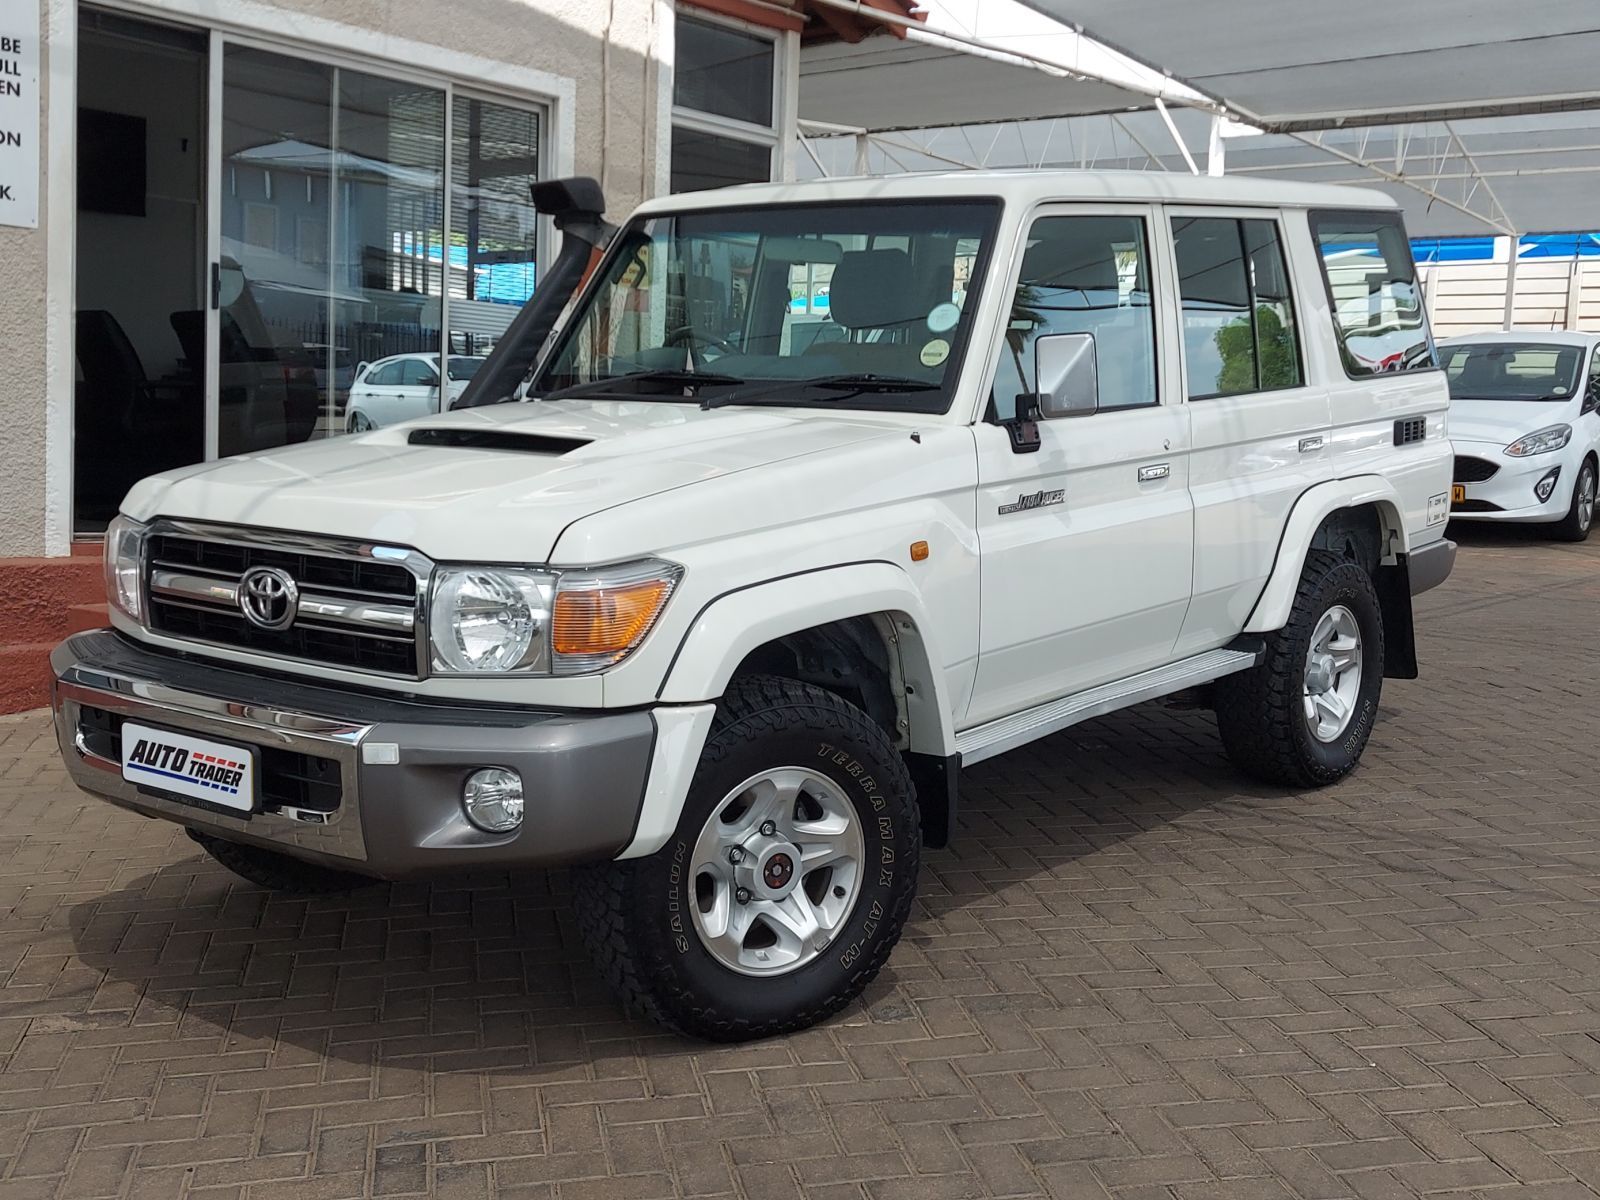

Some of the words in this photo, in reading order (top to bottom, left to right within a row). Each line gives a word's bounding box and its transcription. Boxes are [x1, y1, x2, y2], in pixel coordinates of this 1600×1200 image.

[1, 37, 21, 54] BE
[129, 739, 190, 773] AUTO
[188, 760, 243, 788] TRADER
[817, 743, 895, 888] TERRAMAX
[669, 841, 690, 954] SAILUN
